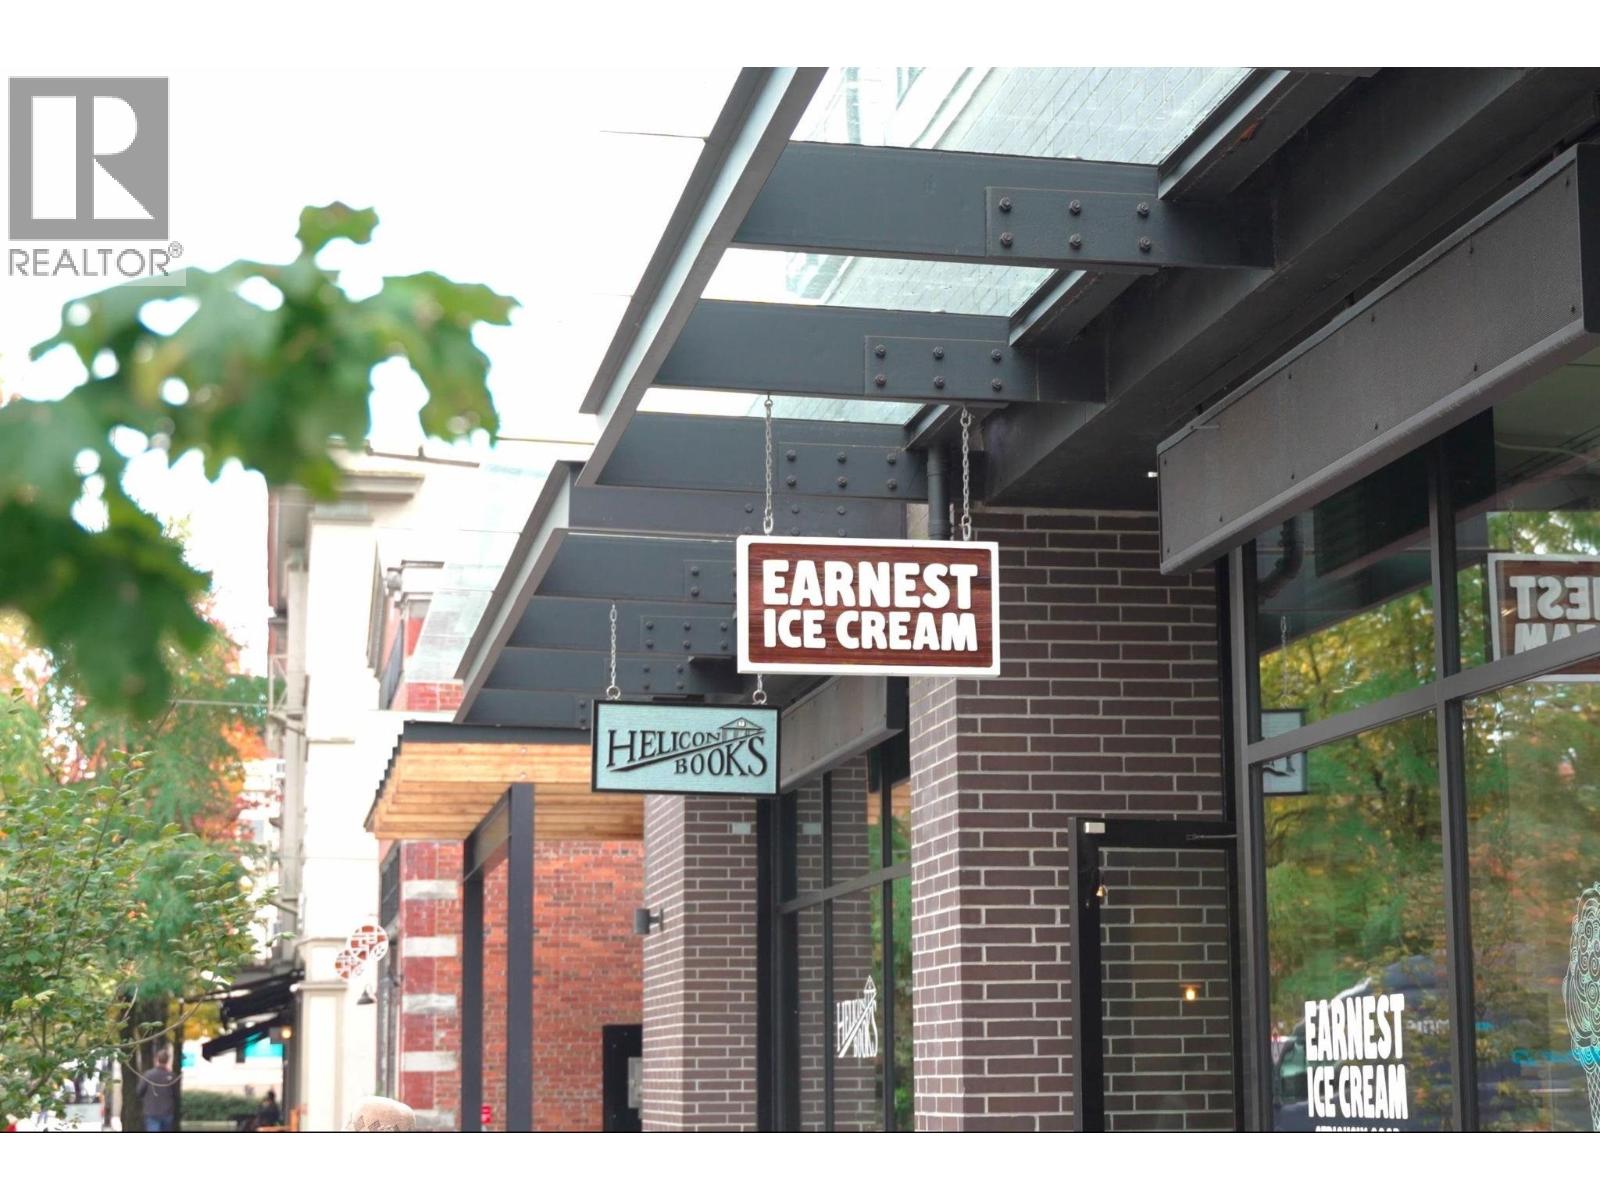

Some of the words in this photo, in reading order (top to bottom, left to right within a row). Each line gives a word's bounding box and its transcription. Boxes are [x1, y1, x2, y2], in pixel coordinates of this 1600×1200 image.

[762, 559, 978, 609] EARNEST
[763, 608, 827, 649] ICE
[835, 609, 978, 652] CREAM
[606, 729, 721, 768] HELICON
[674, 735, 768, 777] BOOKS
[1304, 993, 1405, 1062] EARNEST
[1306, 1065, 1336, 1118] ICE
[1338, 1063, 1409, 1120] CREAM
